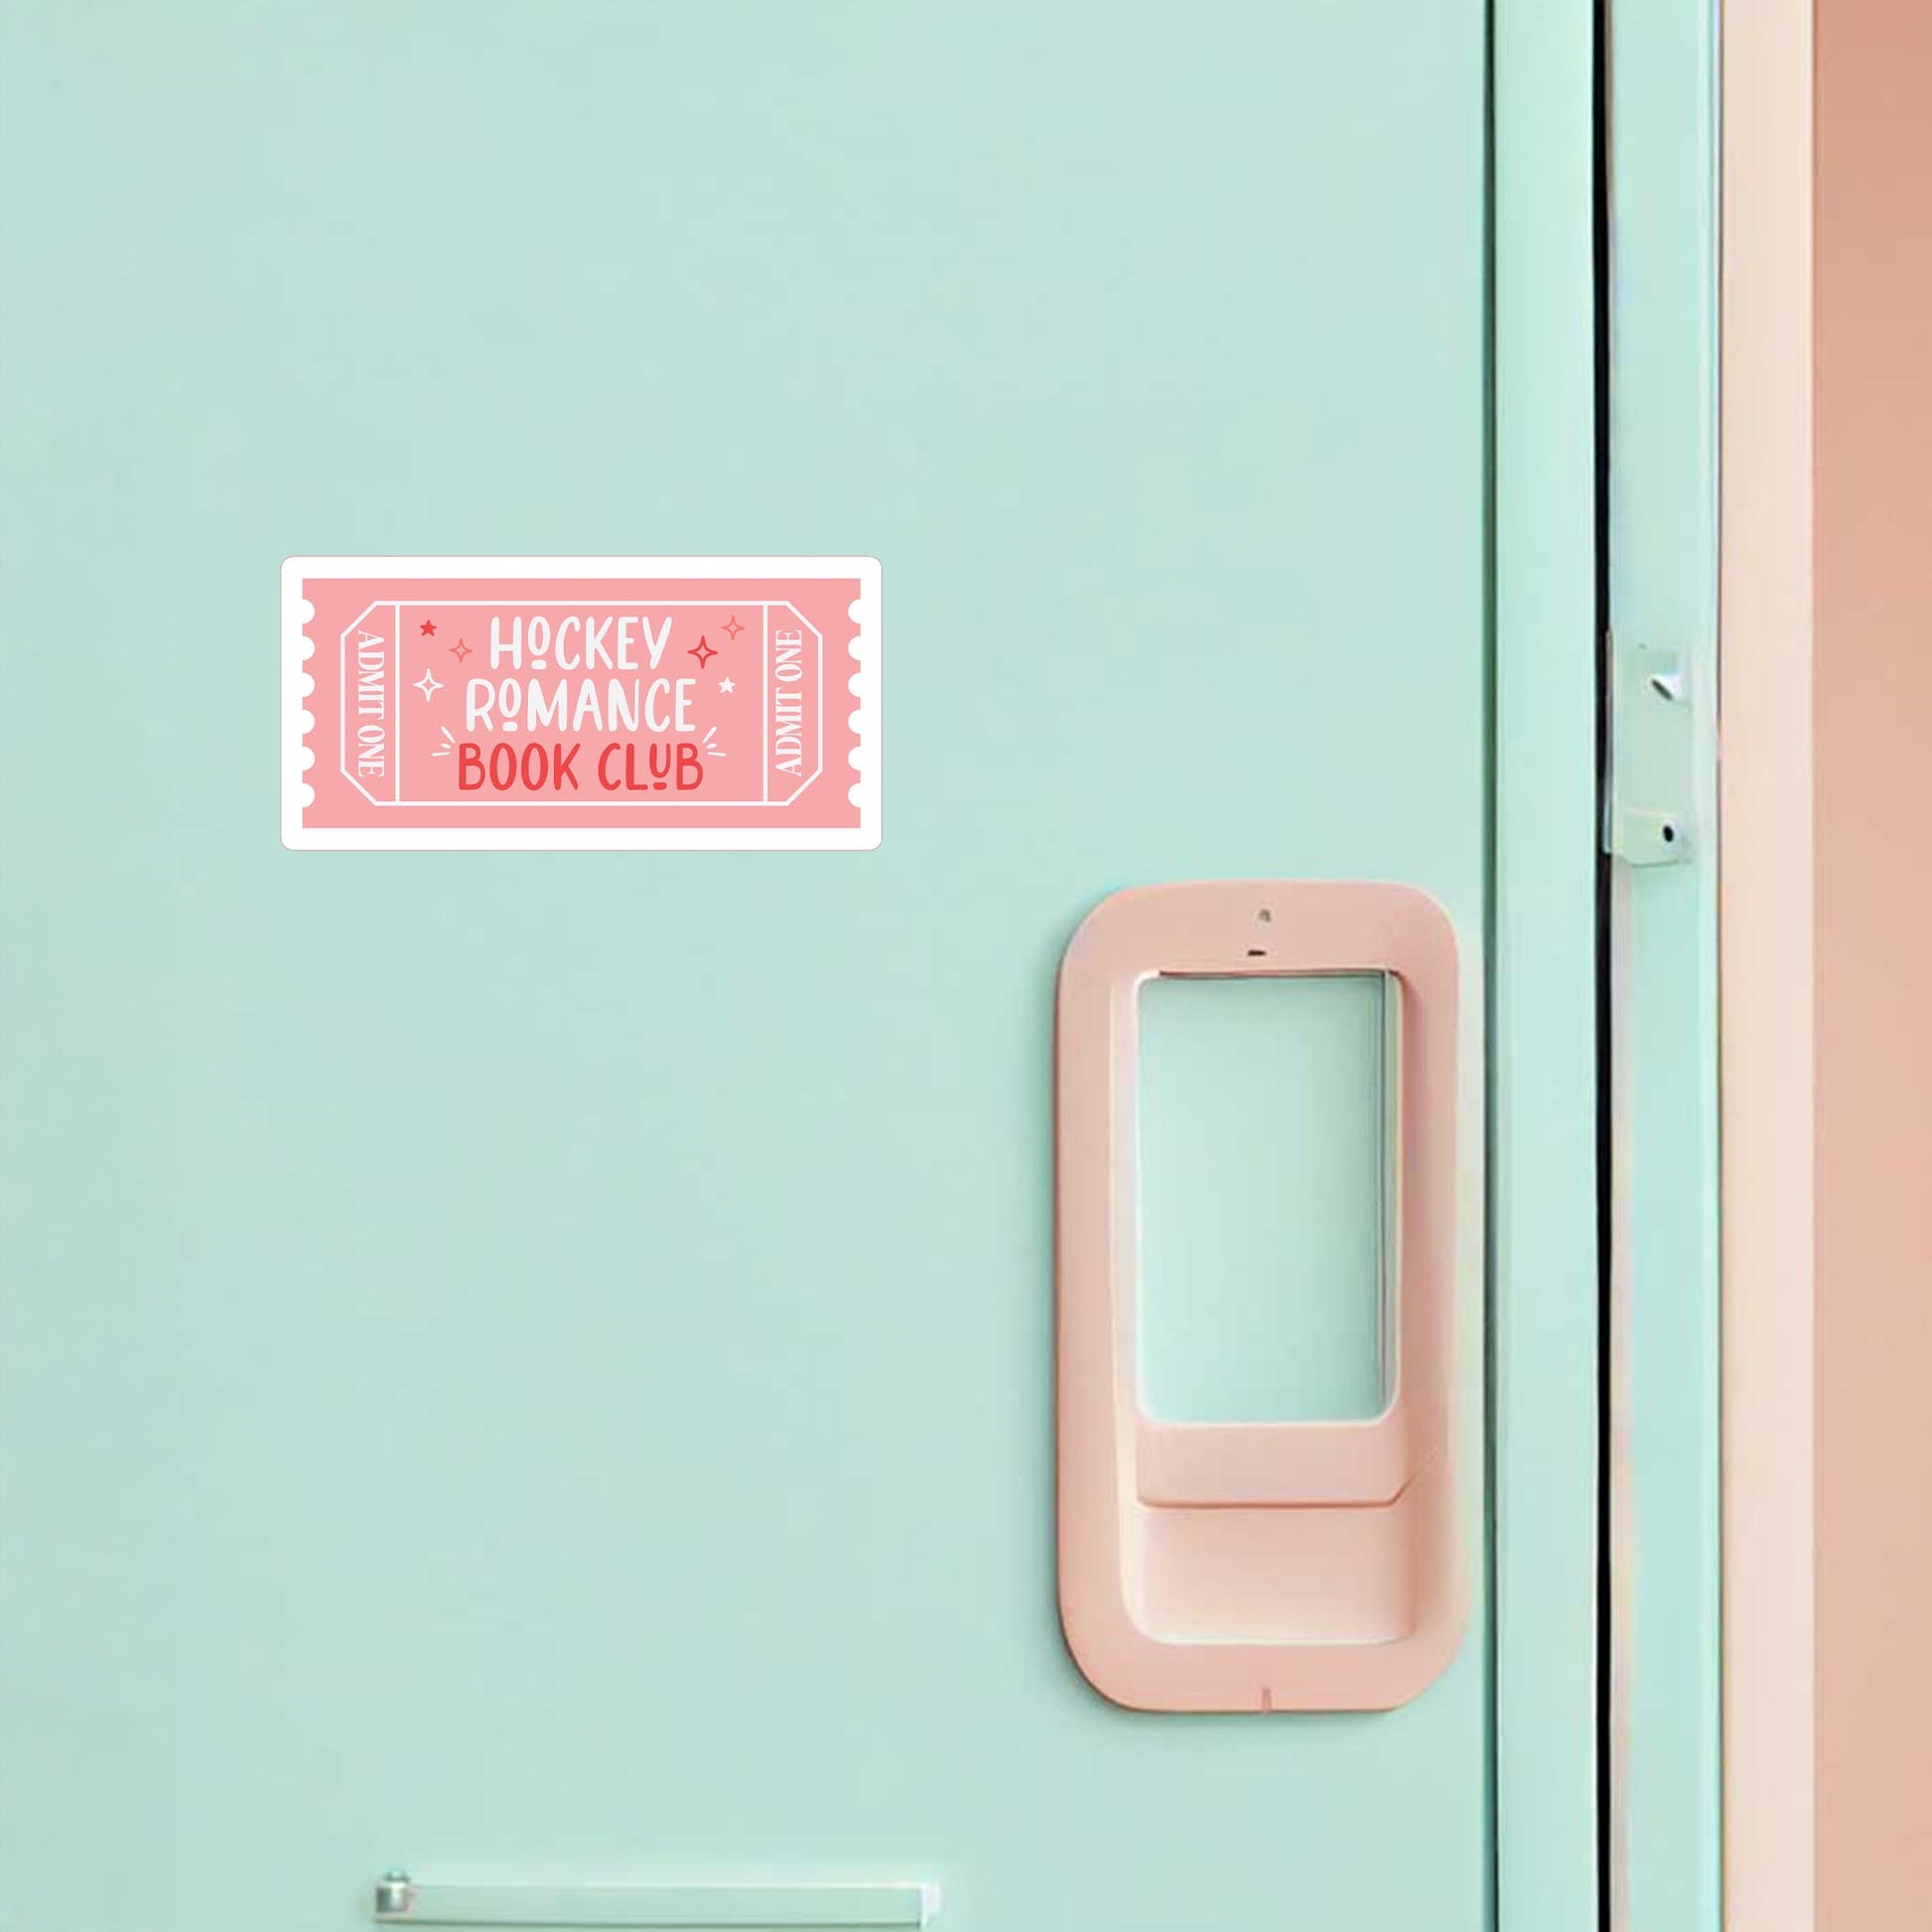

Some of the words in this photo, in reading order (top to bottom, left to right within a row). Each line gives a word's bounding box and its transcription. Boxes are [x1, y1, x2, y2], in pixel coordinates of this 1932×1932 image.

[490, 617, 672, 670] HOCKEY
[774, 629, 802, 681] ONE
[357, 631, 385, 719] ADMIT
[467, 678, 696, 733] ROMANCE
[774, 688, 802, 776] ADMIT
[357, 726, 385, 776] ONE
[459, 743, 581, 791] BOOK
[599, 743, 704, 791] CLUB
